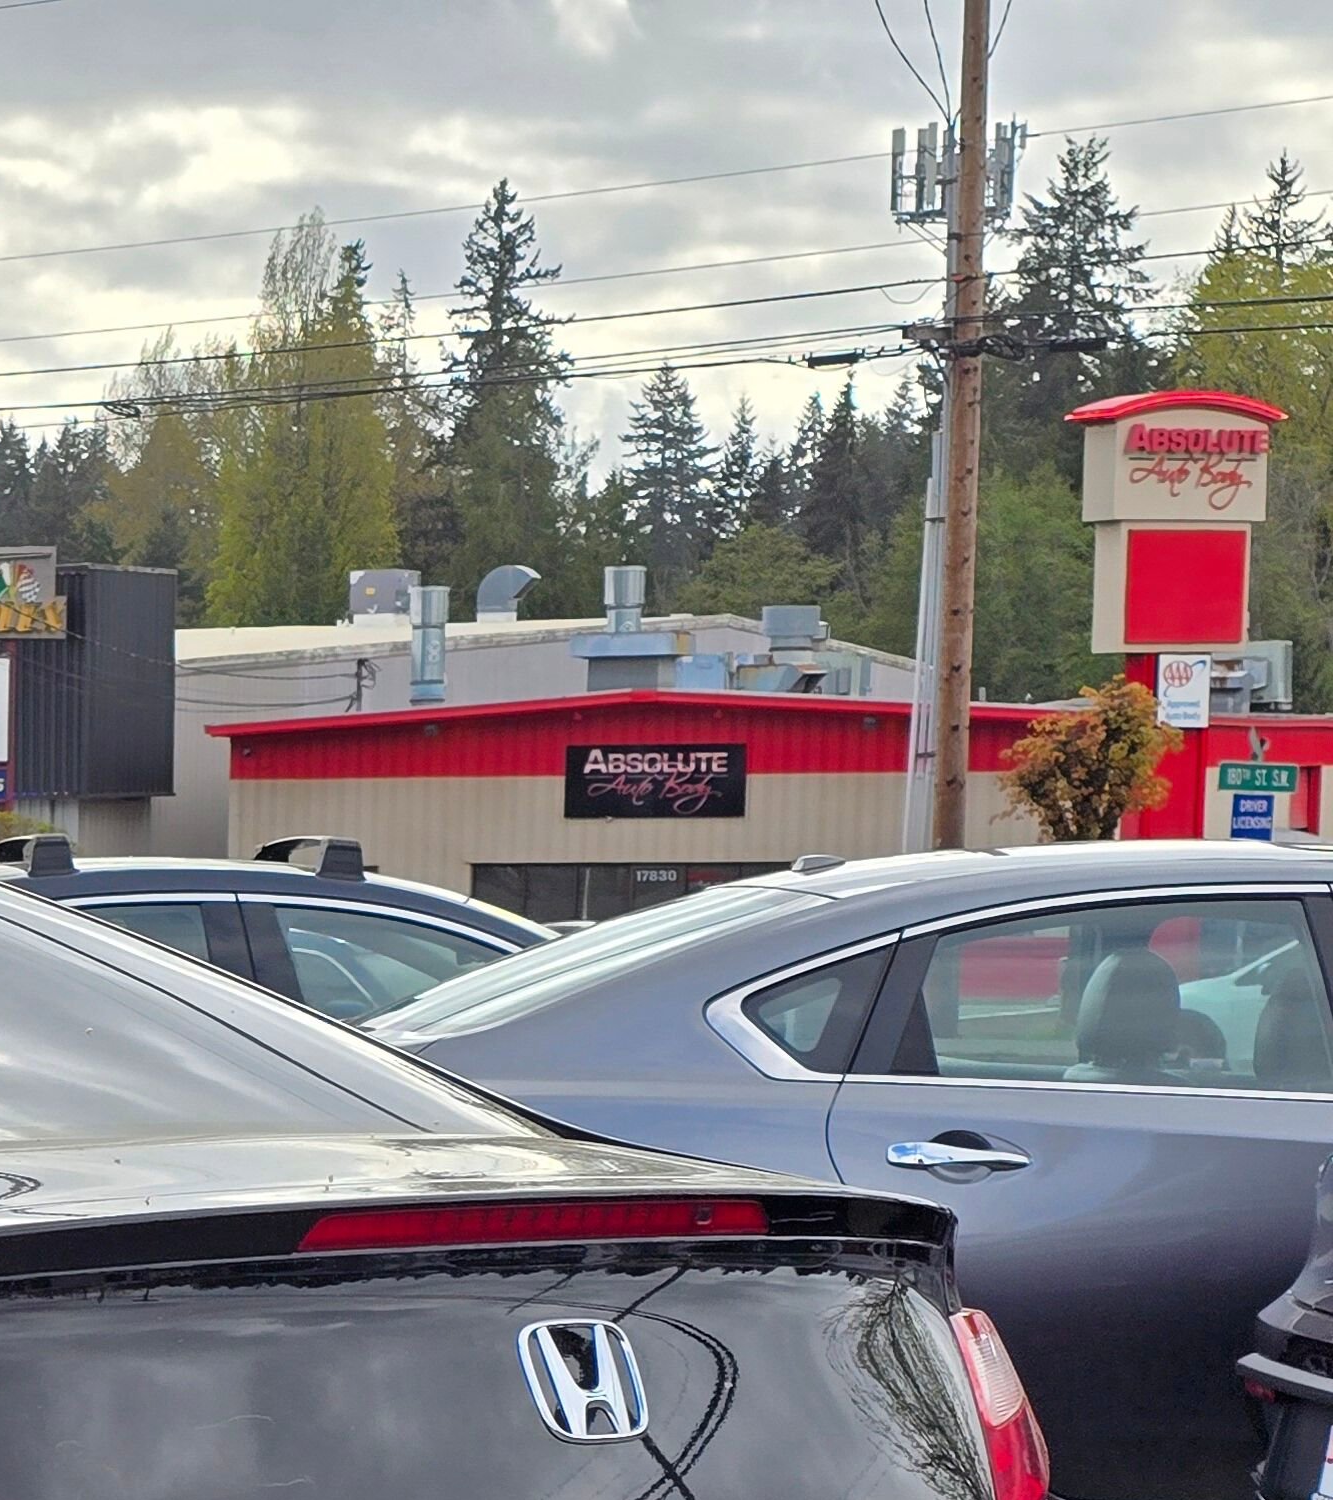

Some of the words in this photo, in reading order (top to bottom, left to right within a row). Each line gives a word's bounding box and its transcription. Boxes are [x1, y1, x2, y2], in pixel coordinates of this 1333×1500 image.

[1124, 423, 1269, 455] ABSOLUTE
[1130, 456, 1197, 497] Auto
[1196, 453, 1253, 511] Body
[583, 749, 729, 774] ABSOLUTE
[587, 774, 661, 805] Auto
[659, 766, 722, 814] Body
[1239, 799, 1268, 813] DRIVER
[1233, 816, 1272, 829] LICENSING
[636, 869, 677, 882] 17830
